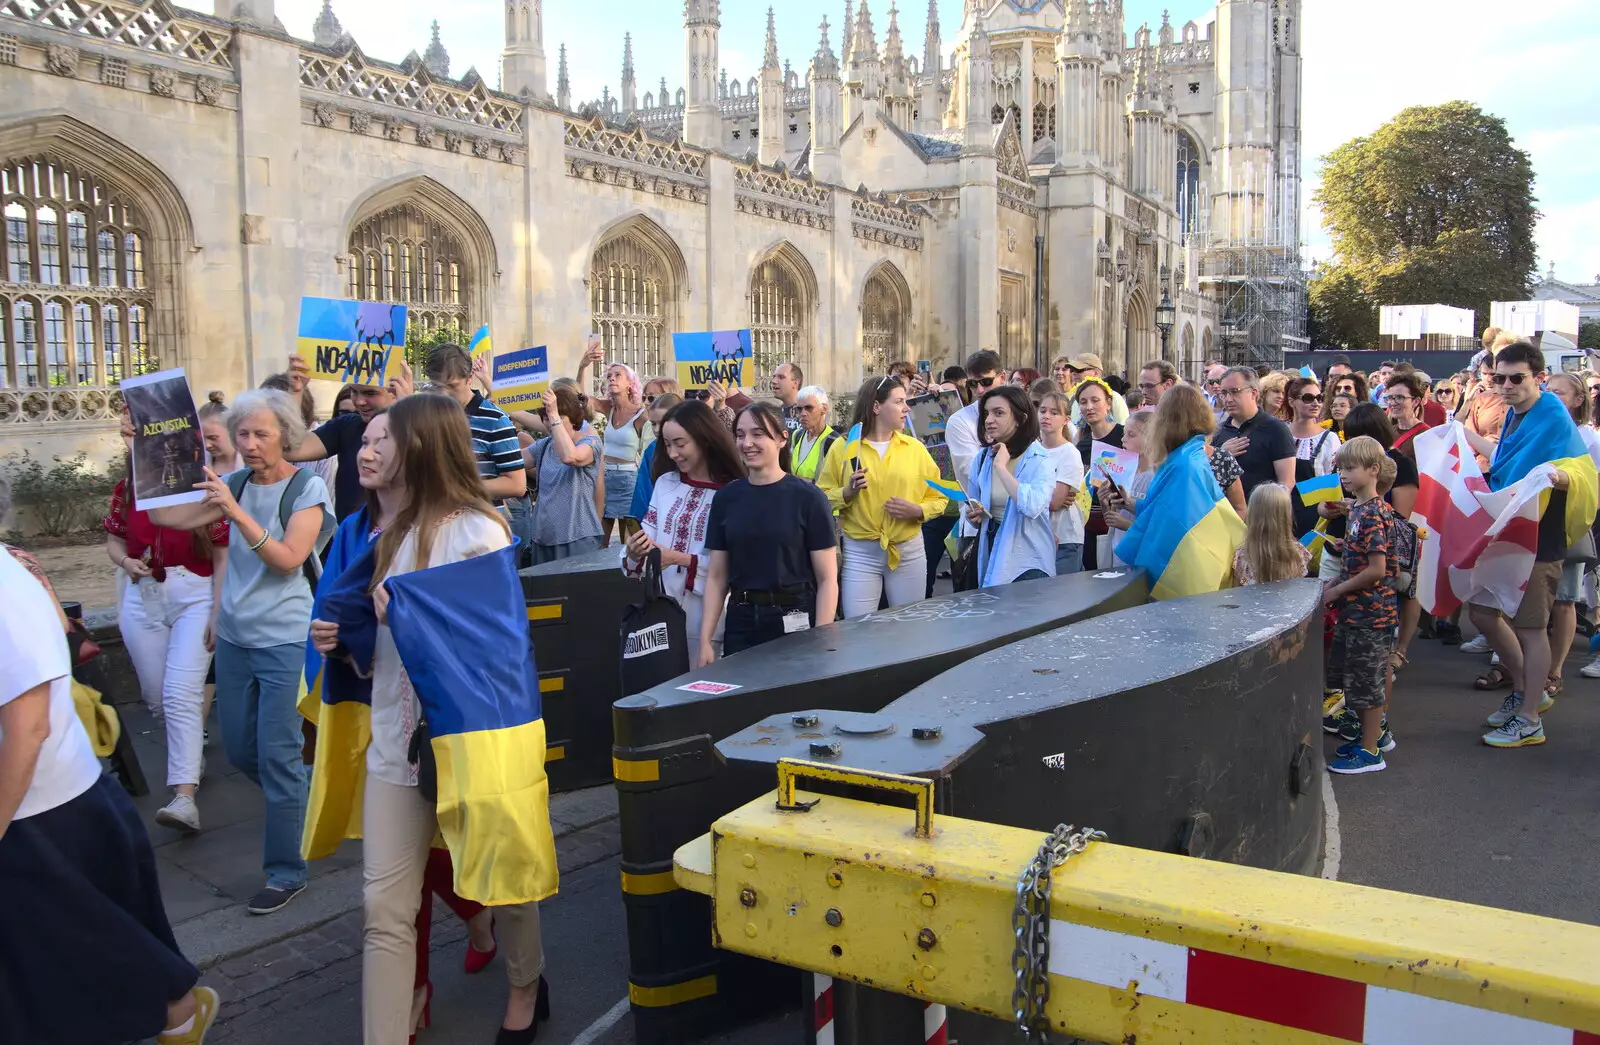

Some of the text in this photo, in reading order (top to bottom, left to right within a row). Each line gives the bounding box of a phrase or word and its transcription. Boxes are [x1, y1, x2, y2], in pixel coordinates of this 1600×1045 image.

[497, 357, 541, 373] INDEPENDENT
[497, 391, 542, 405] НЕЗАЛЕЖНА
[143, 416, 192, 437] AZOVSTAL
